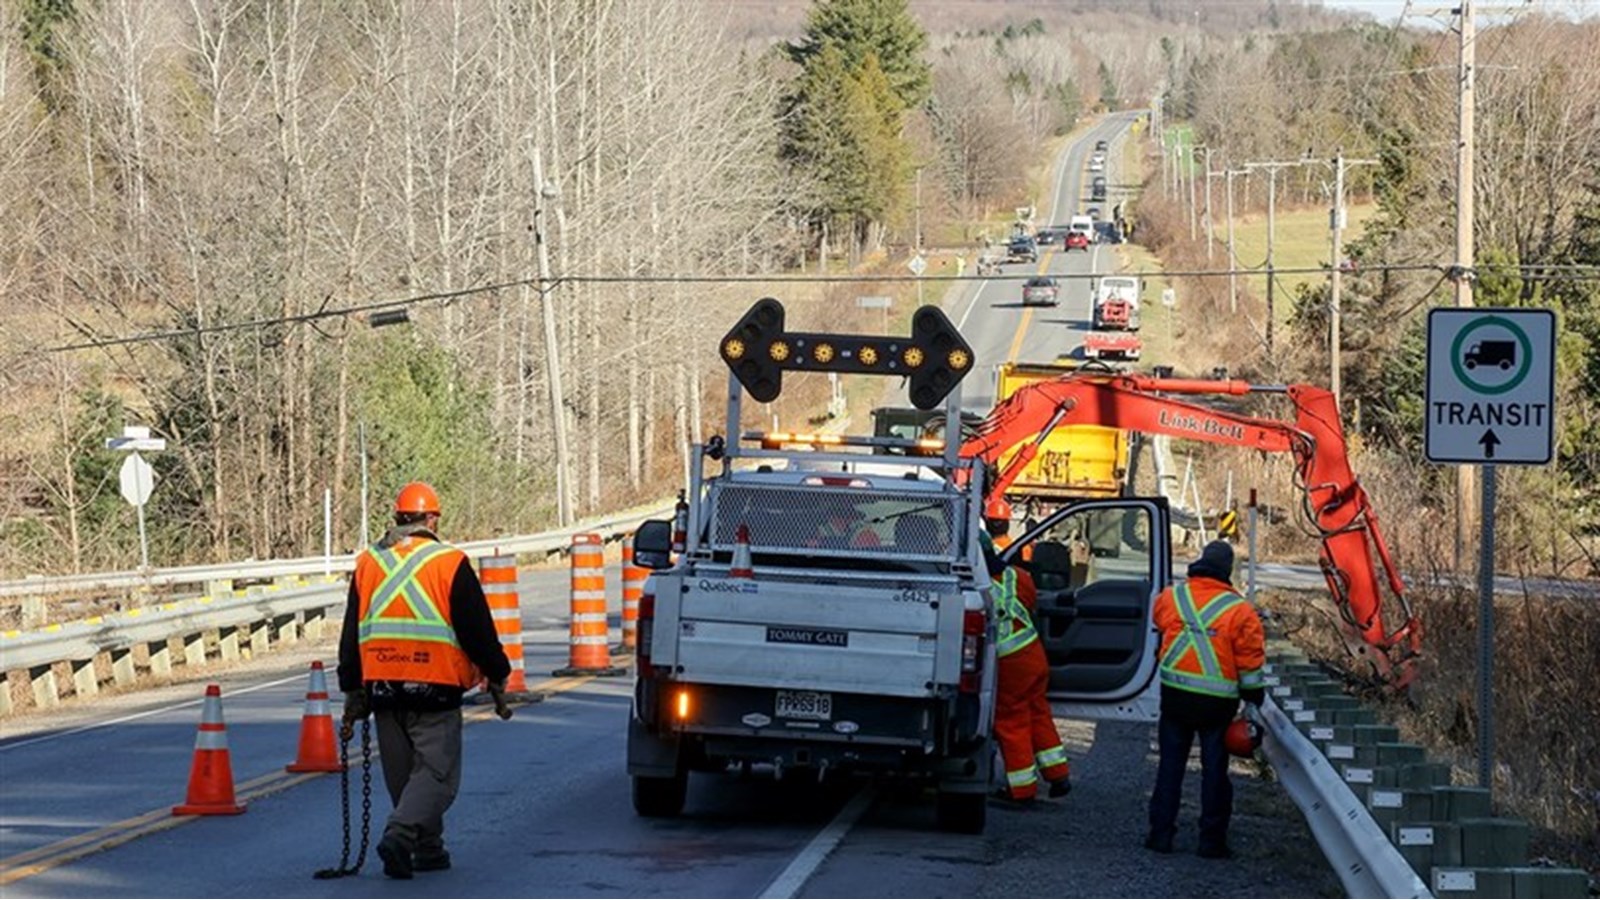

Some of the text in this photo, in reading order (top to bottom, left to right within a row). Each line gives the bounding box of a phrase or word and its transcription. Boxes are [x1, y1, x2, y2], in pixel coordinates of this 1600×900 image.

[1433, 402, 1546, 427] TRANSIT
[769, 630, 845, 645] TOMMY GATE
